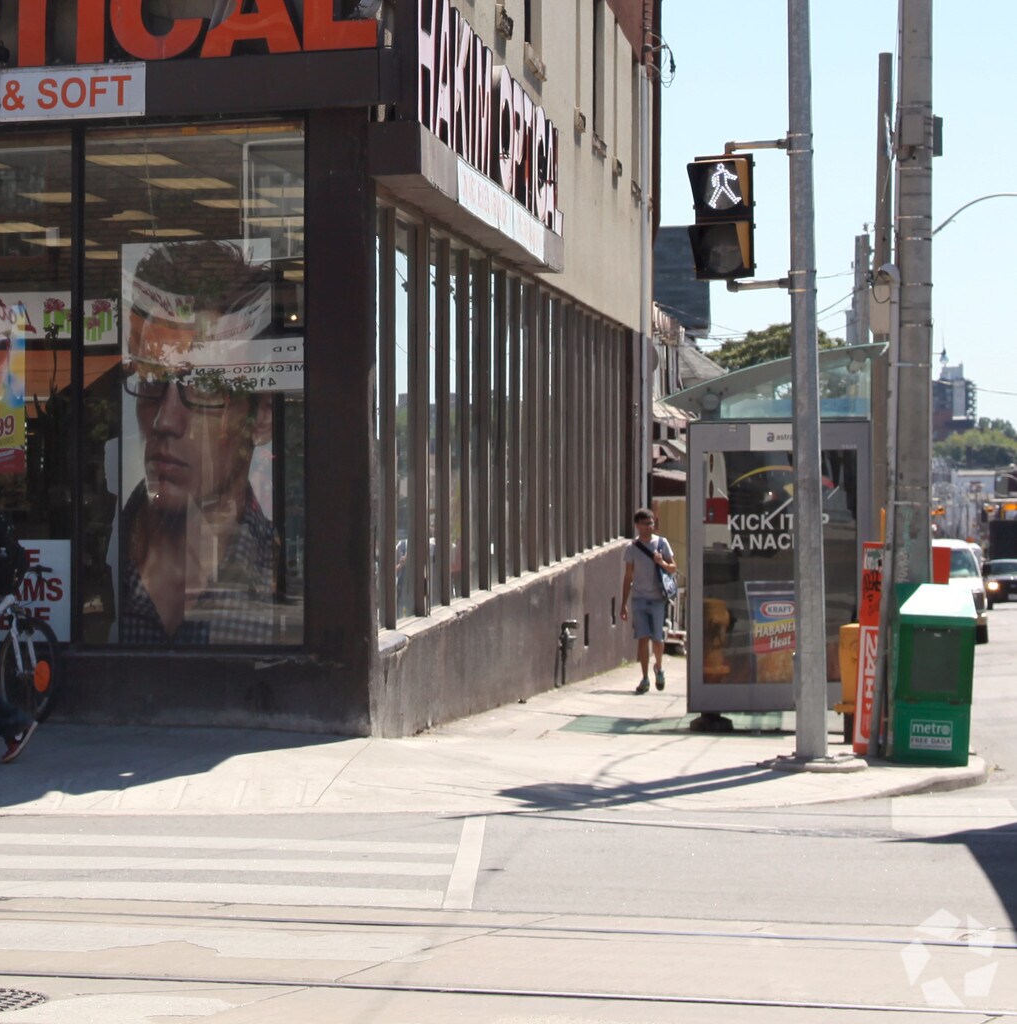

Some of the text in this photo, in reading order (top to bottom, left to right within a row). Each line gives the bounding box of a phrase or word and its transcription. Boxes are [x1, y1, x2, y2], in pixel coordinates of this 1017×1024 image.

[1, 79, 26, 111] &
[36, 74, 133, 109] SOFT
[727, 513, 774, 531] KICK
[731, 533, 795, 550] A NAC
[767, 605, 792, 613] KRAFT
[769, 635, 791, 650] Heat
[912, 723, 951, 735] metro
